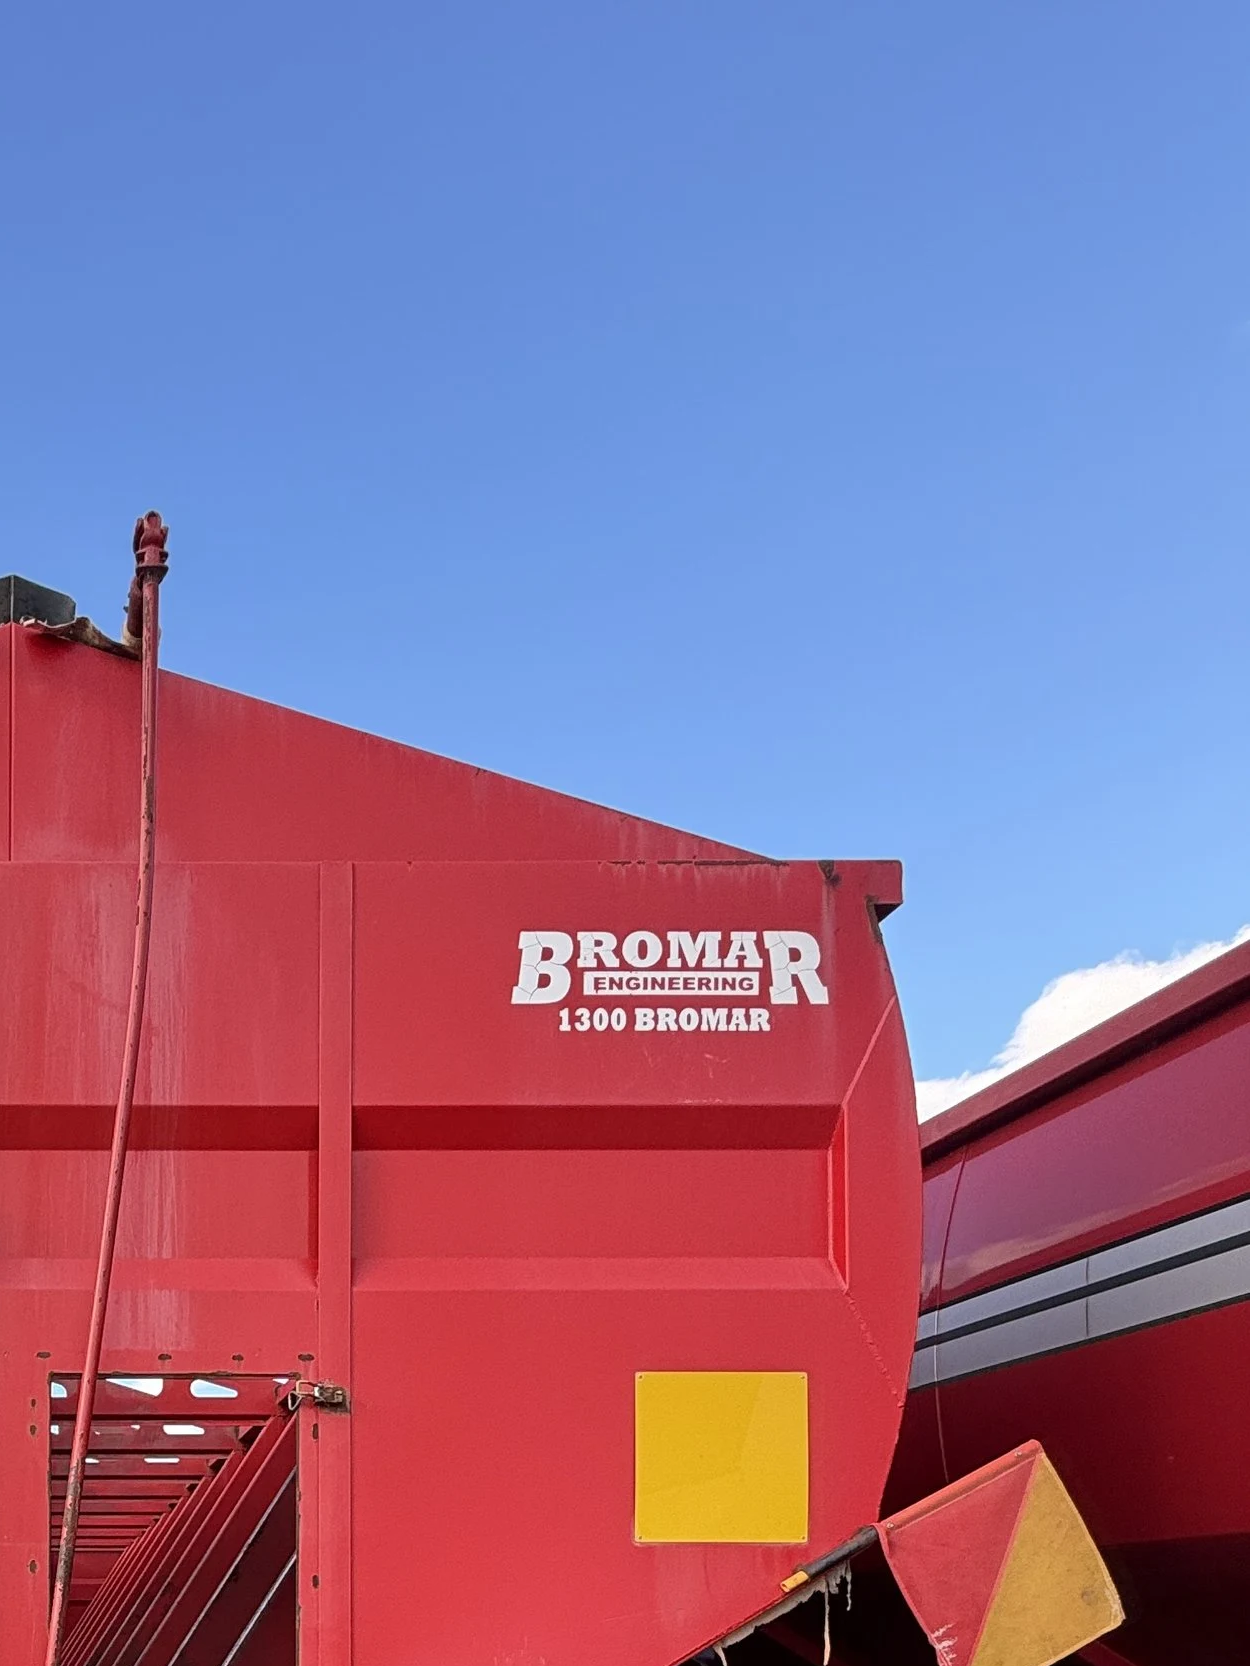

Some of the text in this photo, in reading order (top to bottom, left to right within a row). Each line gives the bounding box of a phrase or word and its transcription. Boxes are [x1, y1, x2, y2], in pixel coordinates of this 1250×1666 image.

[511, 931, 829, 1004] BROMAR
[594, 976, 755, 992] ENGINEERING
[559, 1008, 771, 1032] 1300 BROMAR
